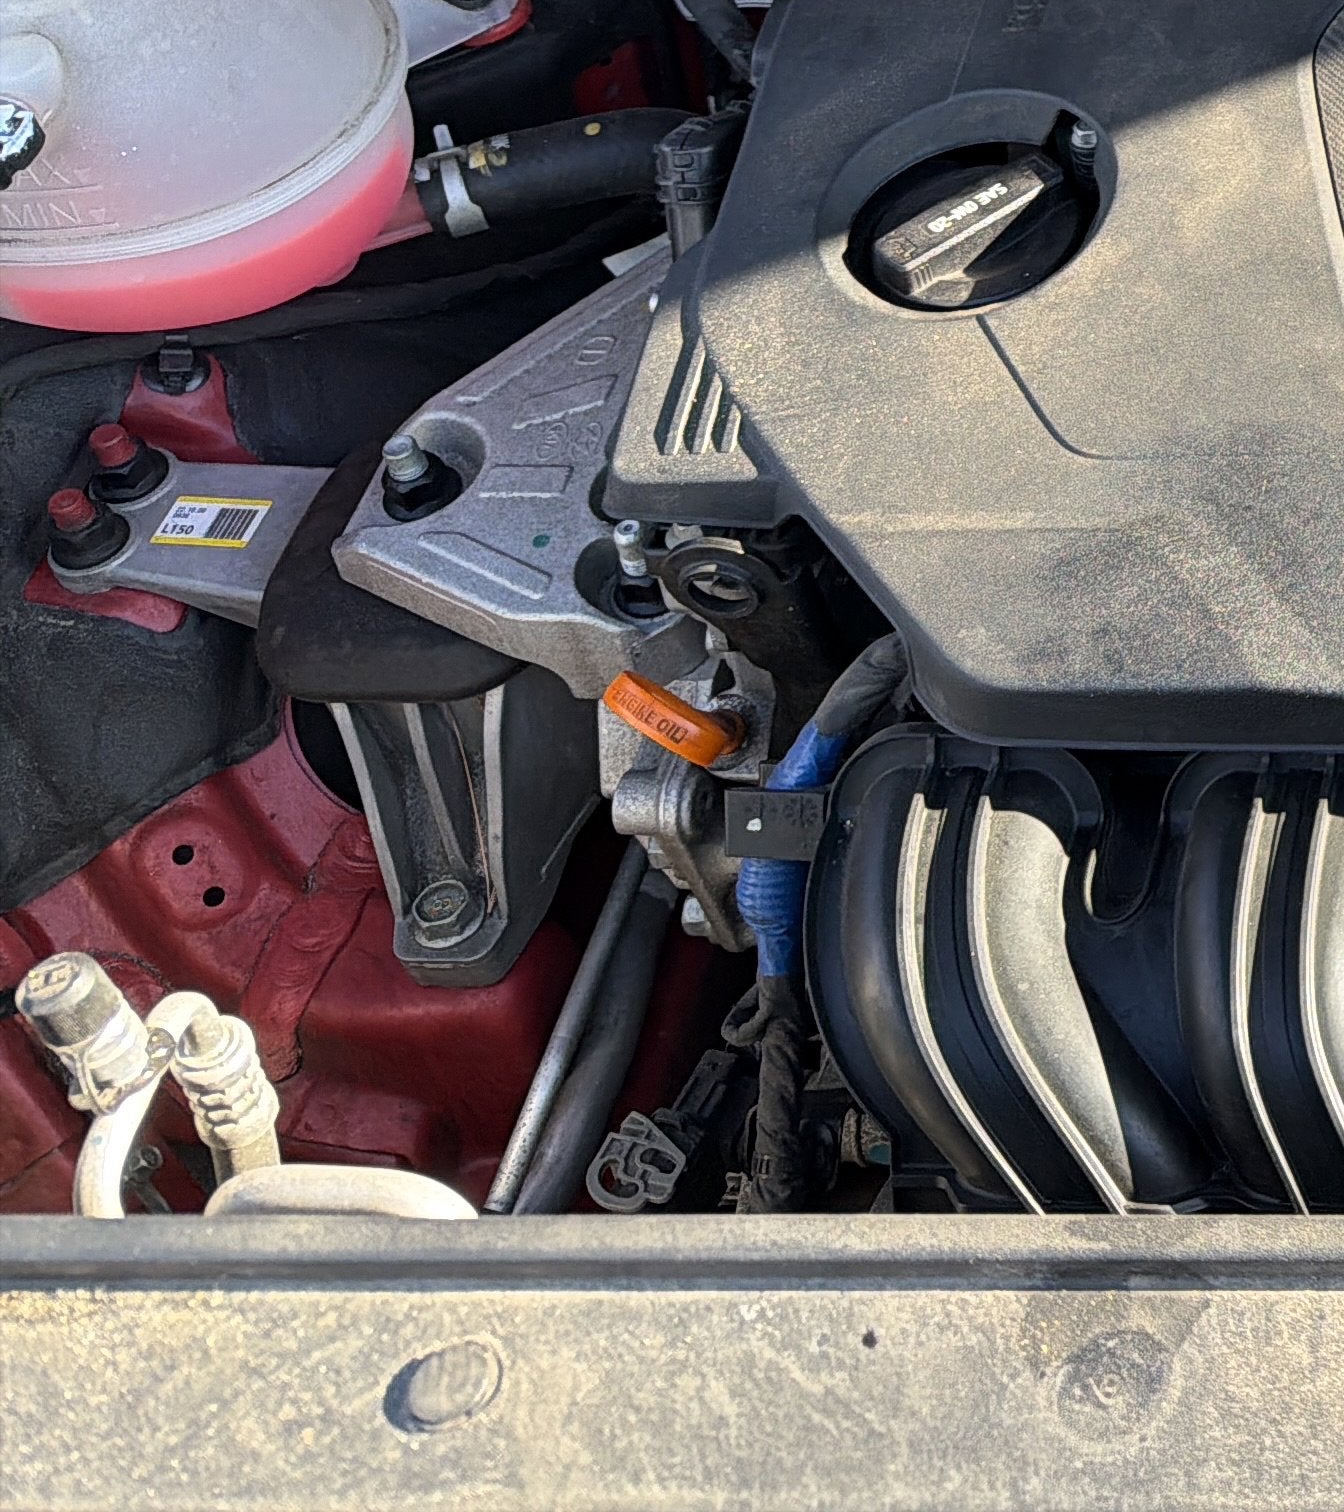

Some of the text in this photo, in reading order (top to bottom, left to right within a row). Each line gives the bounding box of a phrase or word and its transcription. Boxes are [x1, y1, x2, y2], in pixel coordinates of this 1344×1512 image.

[1, 200, 81, 227] MIN
[927, 182, 1009, 233] SAE 0W-20
